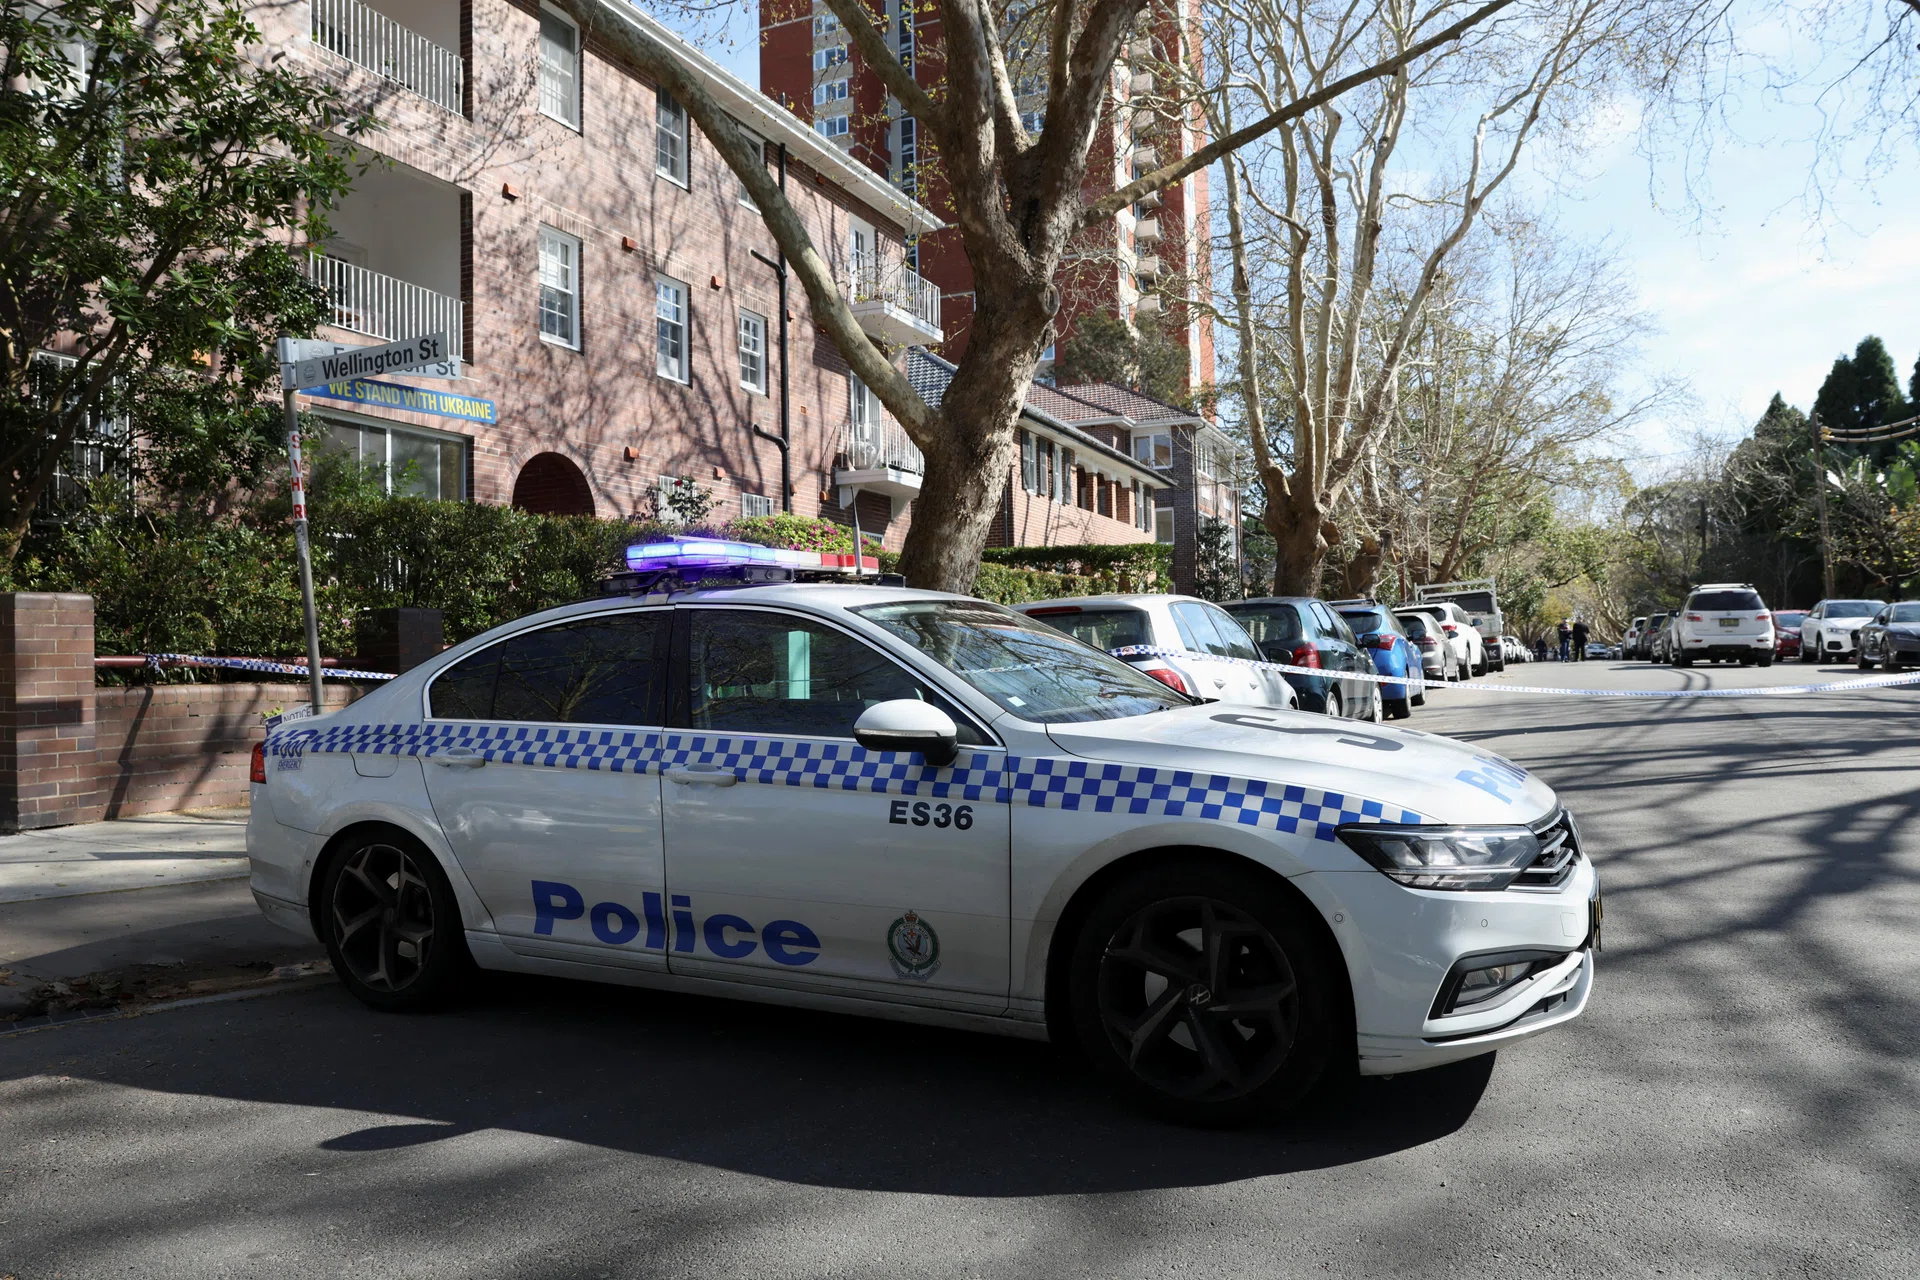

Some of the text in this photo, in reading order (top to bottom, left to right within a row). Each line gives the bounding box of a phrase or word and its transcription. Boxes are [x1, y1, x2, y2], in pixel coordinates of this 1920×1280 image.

[322, 338, 439, 380] Wellington St
[435, 359, 456, 376] St
[329, 380, 492, 419] WE STAND WITH UKRAINE
[283, 707, 311, 722] NOTICE
[280, 739, 308, 758] 000
[889, 800, 973, 830] ES36
[531, 880, 821, 966] Police
